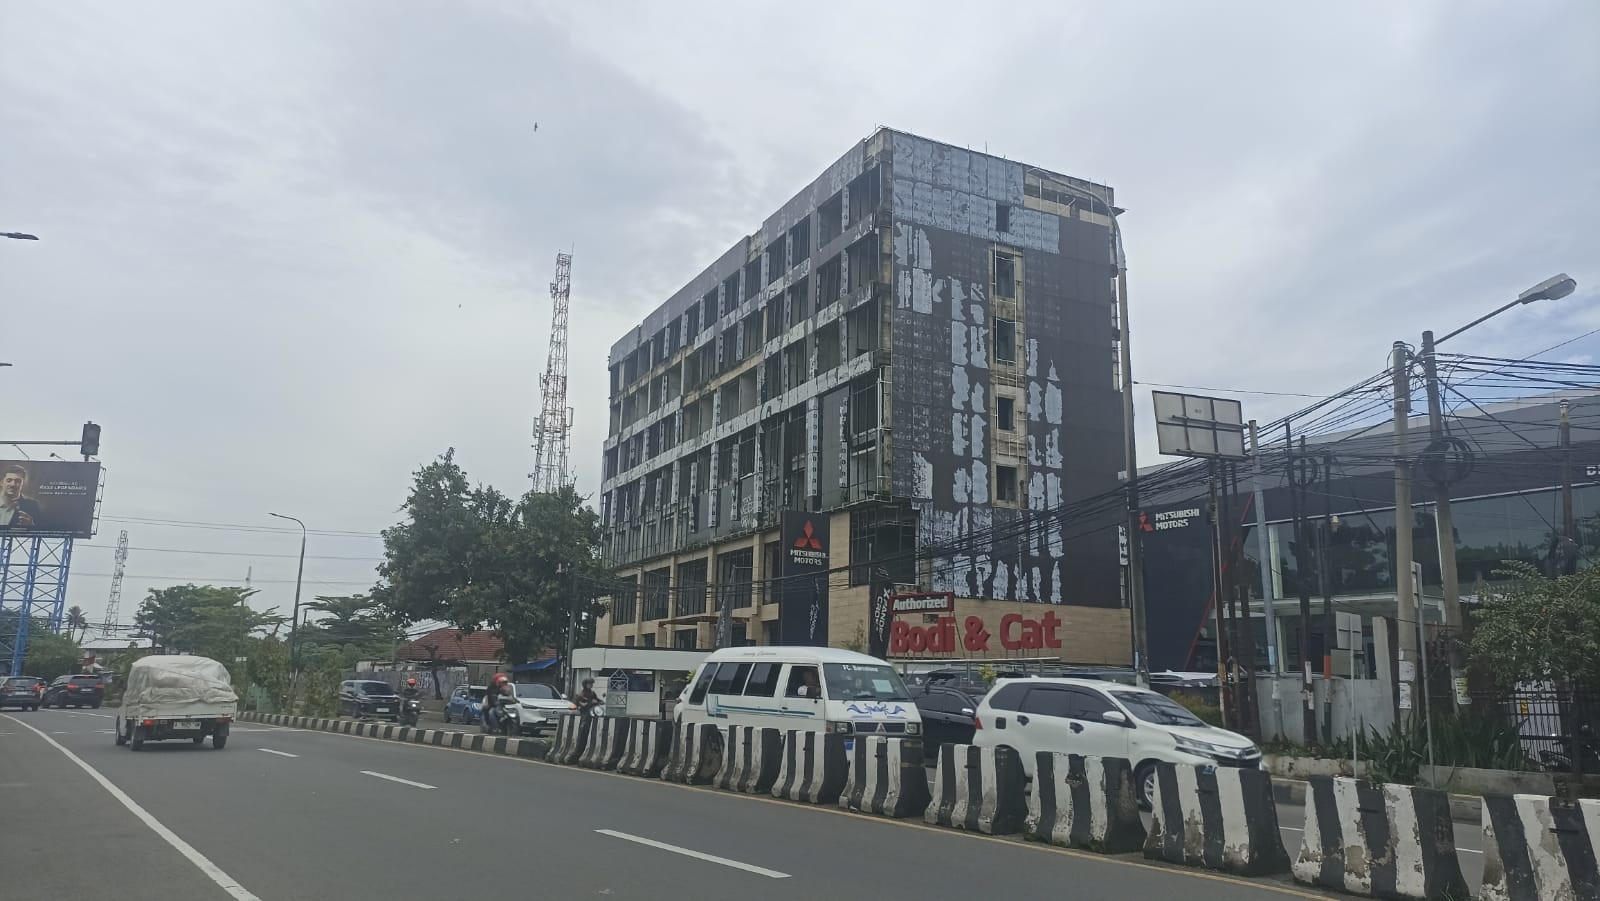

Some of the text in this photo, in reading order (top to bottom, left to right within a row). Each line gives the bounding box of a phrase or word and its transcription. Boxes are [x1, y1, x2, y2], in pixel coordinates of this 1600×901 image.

[1155, 509, 1200, 520] MITSUBISHI
[1155, 518, 1189, 530] MOTORS
[793, 556, 822, 566] MOTORS
[893, 596, 948, 611] Authorized
[890, 610, 1062, 652] Bodi & Cat
